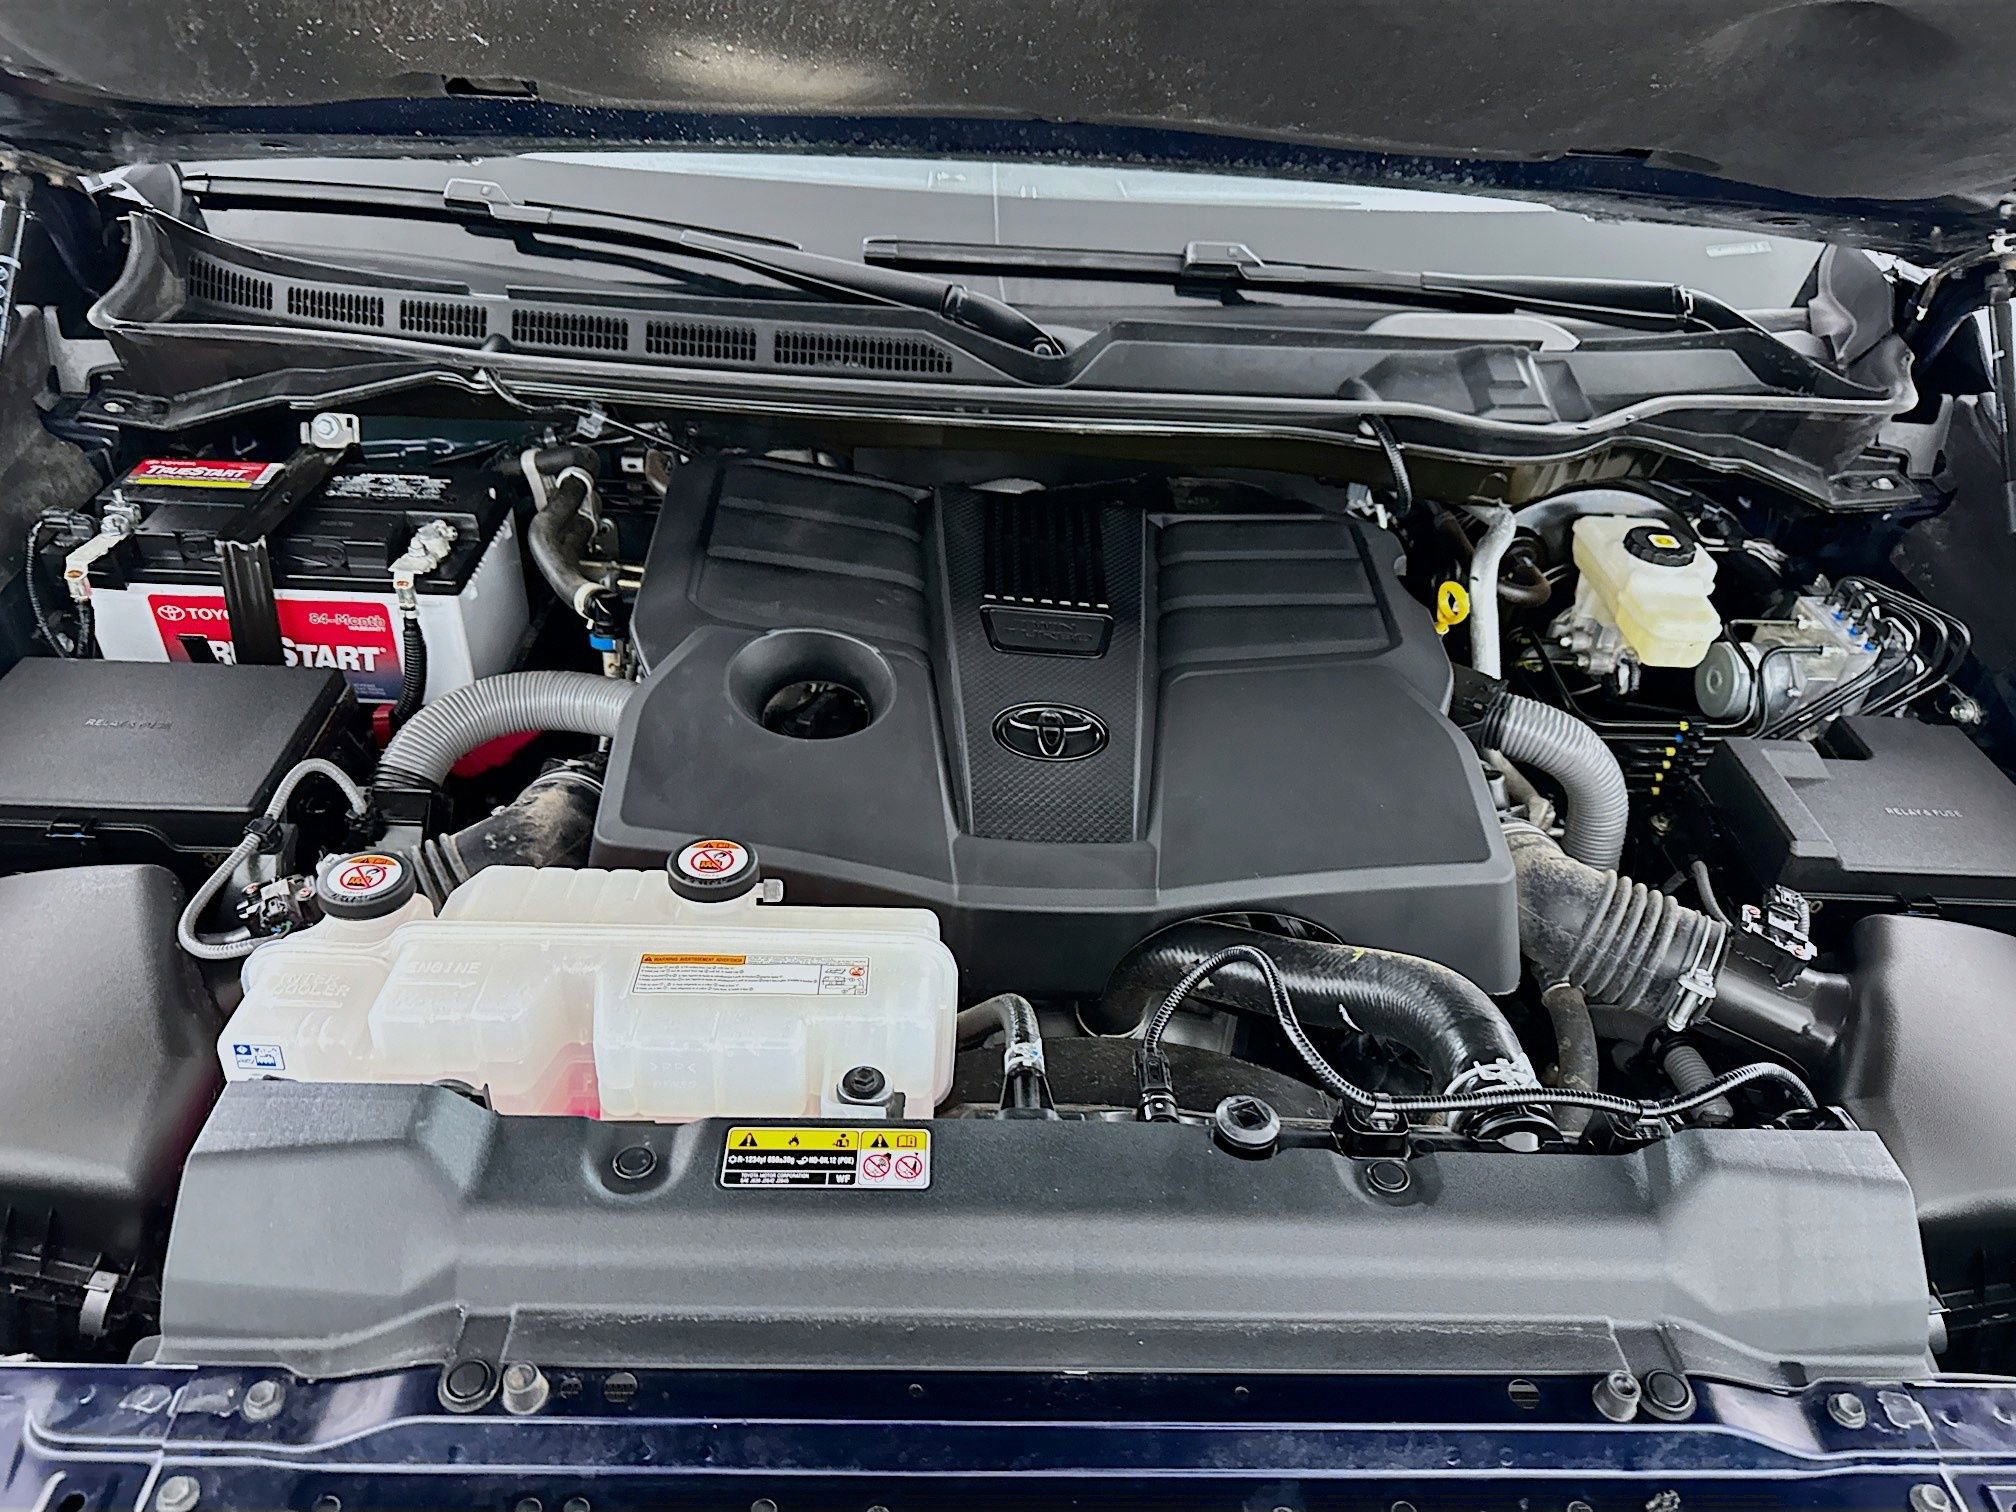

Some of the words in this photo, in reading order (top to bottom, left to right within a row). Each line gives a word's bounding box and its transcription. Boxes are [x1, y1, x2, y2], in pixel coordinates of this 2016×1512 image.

[185, 608, 229, 620] TOY
[1885, 807, 1922, 816] RELAY
[1932, 809, 1963, 818] FUSE
[409, 961, 483, 974] ENGINE
[836, 1174, 850, 1183] WF
